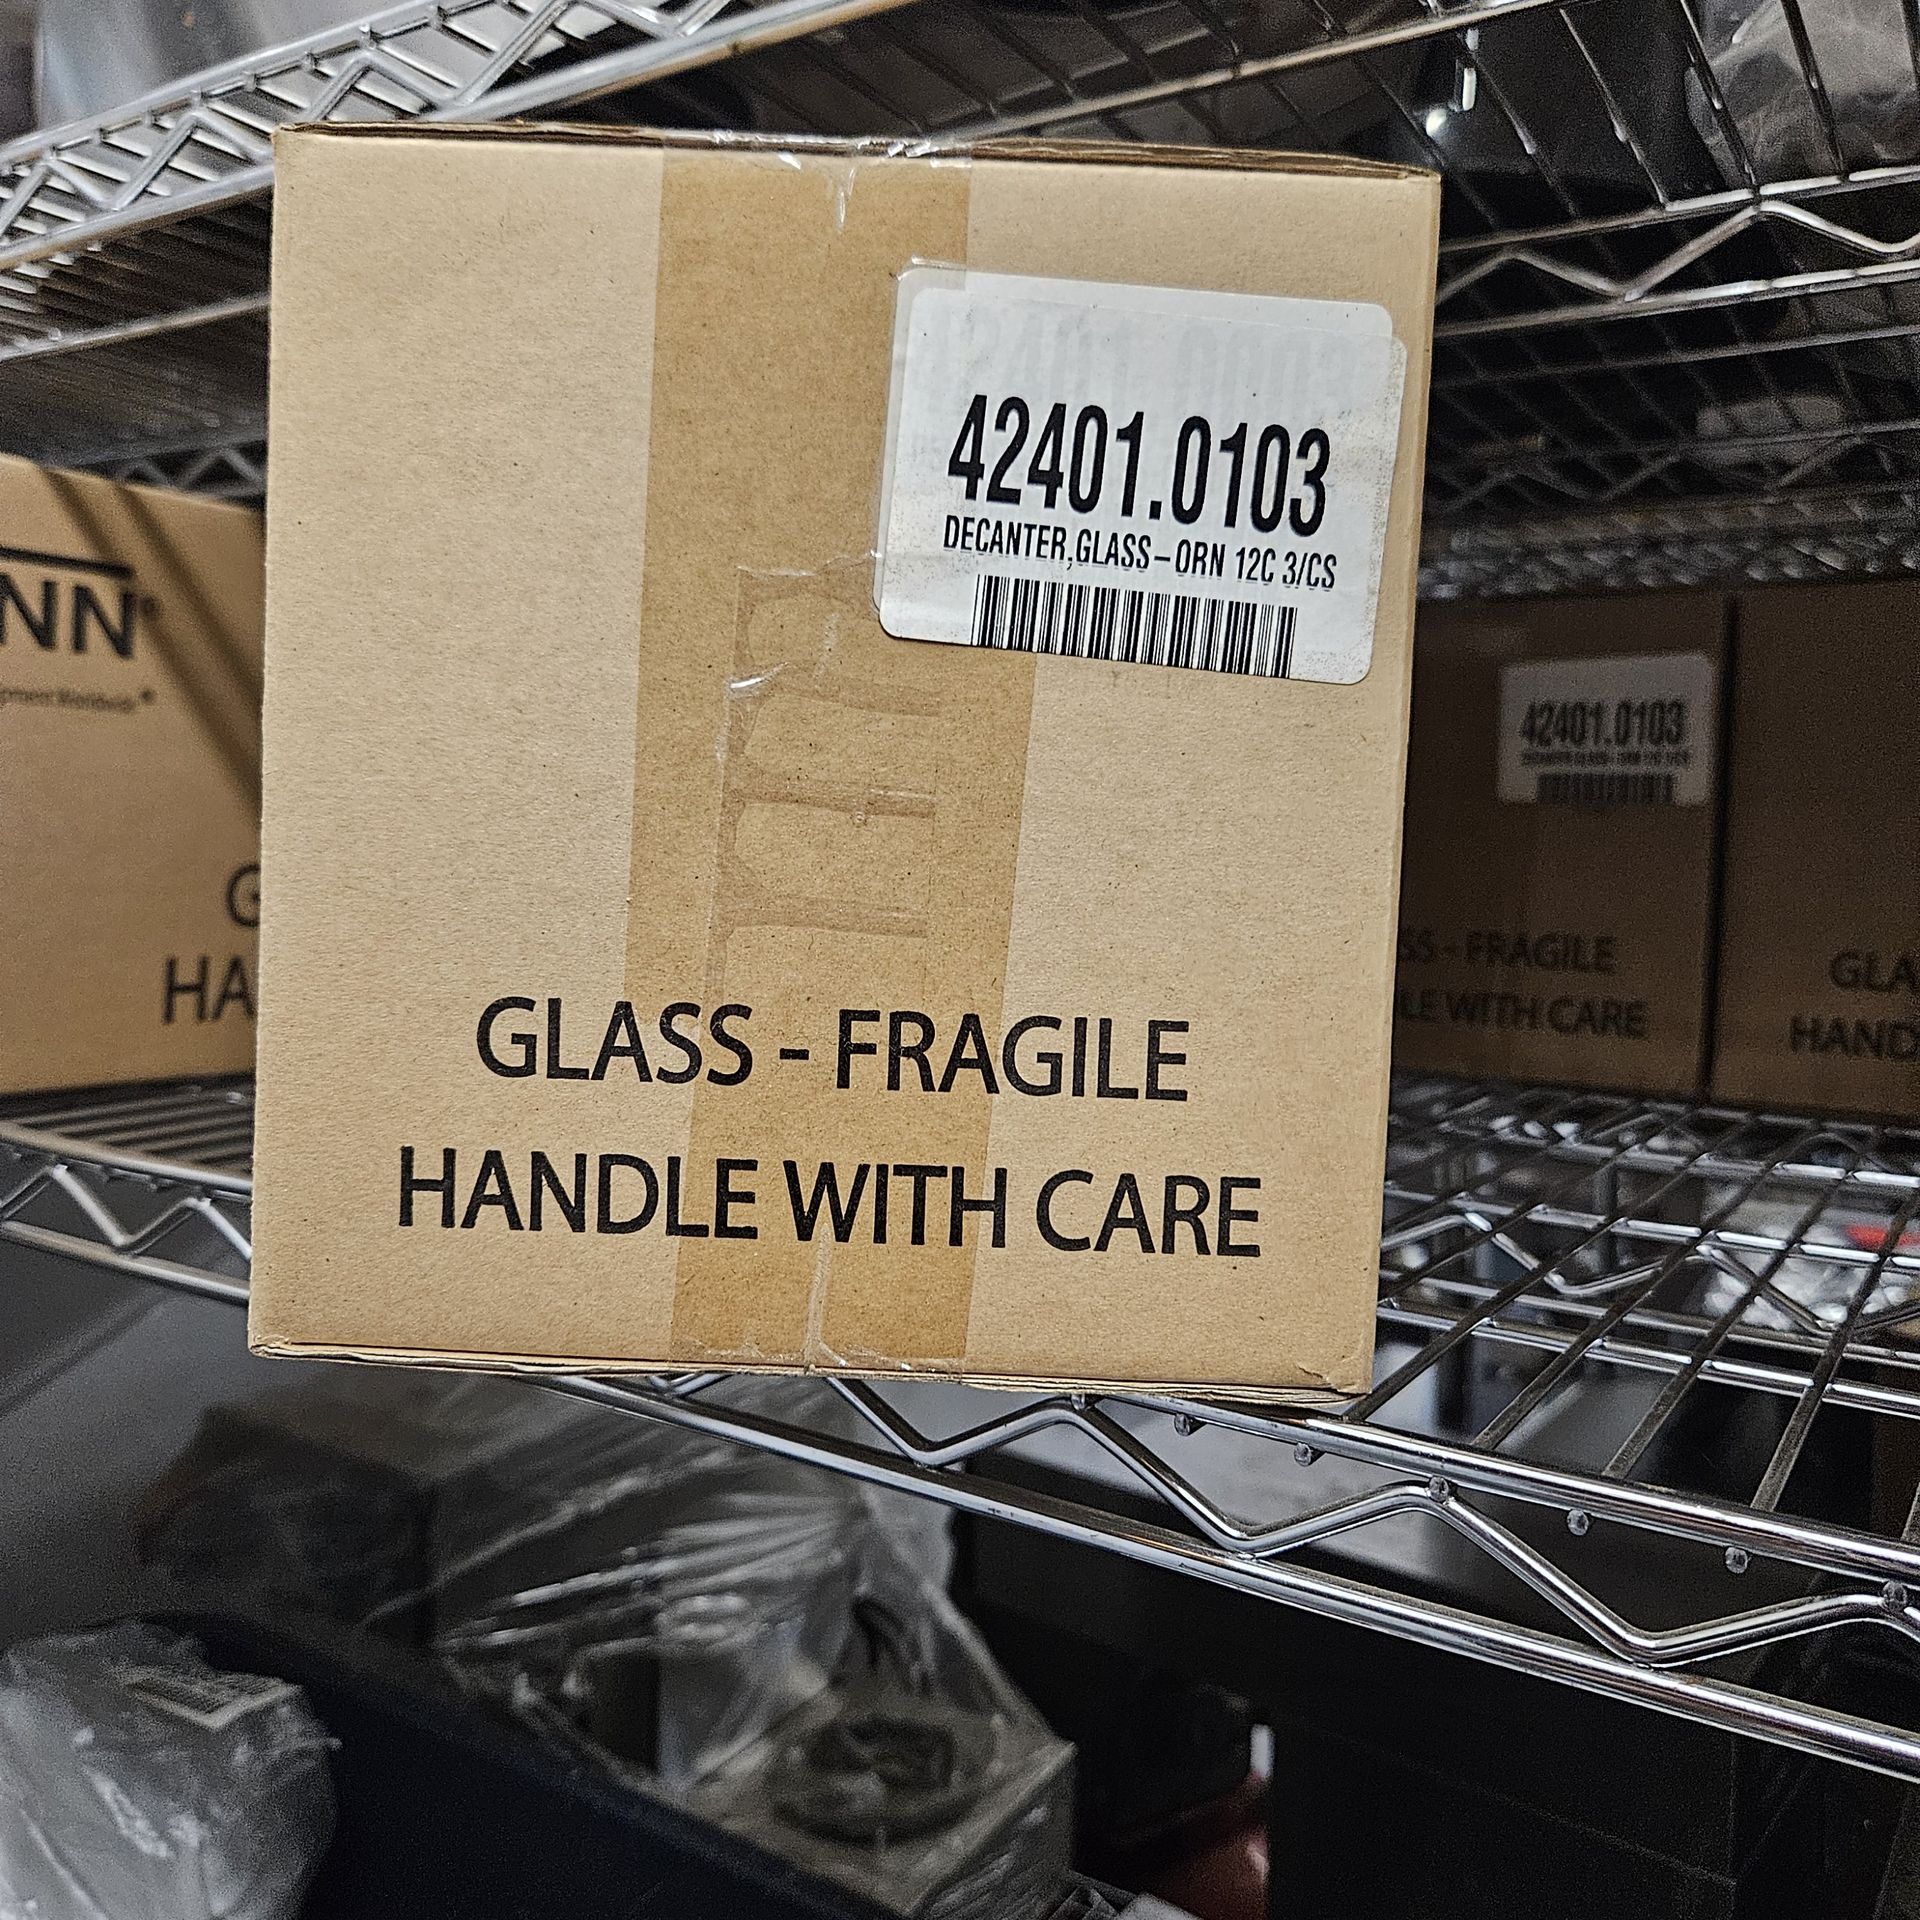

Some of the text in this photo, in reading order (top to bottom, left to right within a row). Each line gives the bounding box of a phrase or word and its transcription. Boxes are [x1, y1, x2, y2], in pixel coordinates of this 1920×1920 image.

[947, 393, 1332, 537] 42401.0103
[1235, 546, 1276, 584] 12C
[1282, 551, 1337, 592] 3/CS
[1520, 699, 1685, 746] 42401.0103
[1464, 931, 1617, 974] FRAGILE
[1444, 990, 1541, 1029] WITH
[1546, 996, 1649, 1038] CARE
[477, 997, 754, 1086] GLASS
[836, 1009, 1190, 1102] FRAGILE
[400, 1145, 1262, 1258] HANDLE WITH CARE
